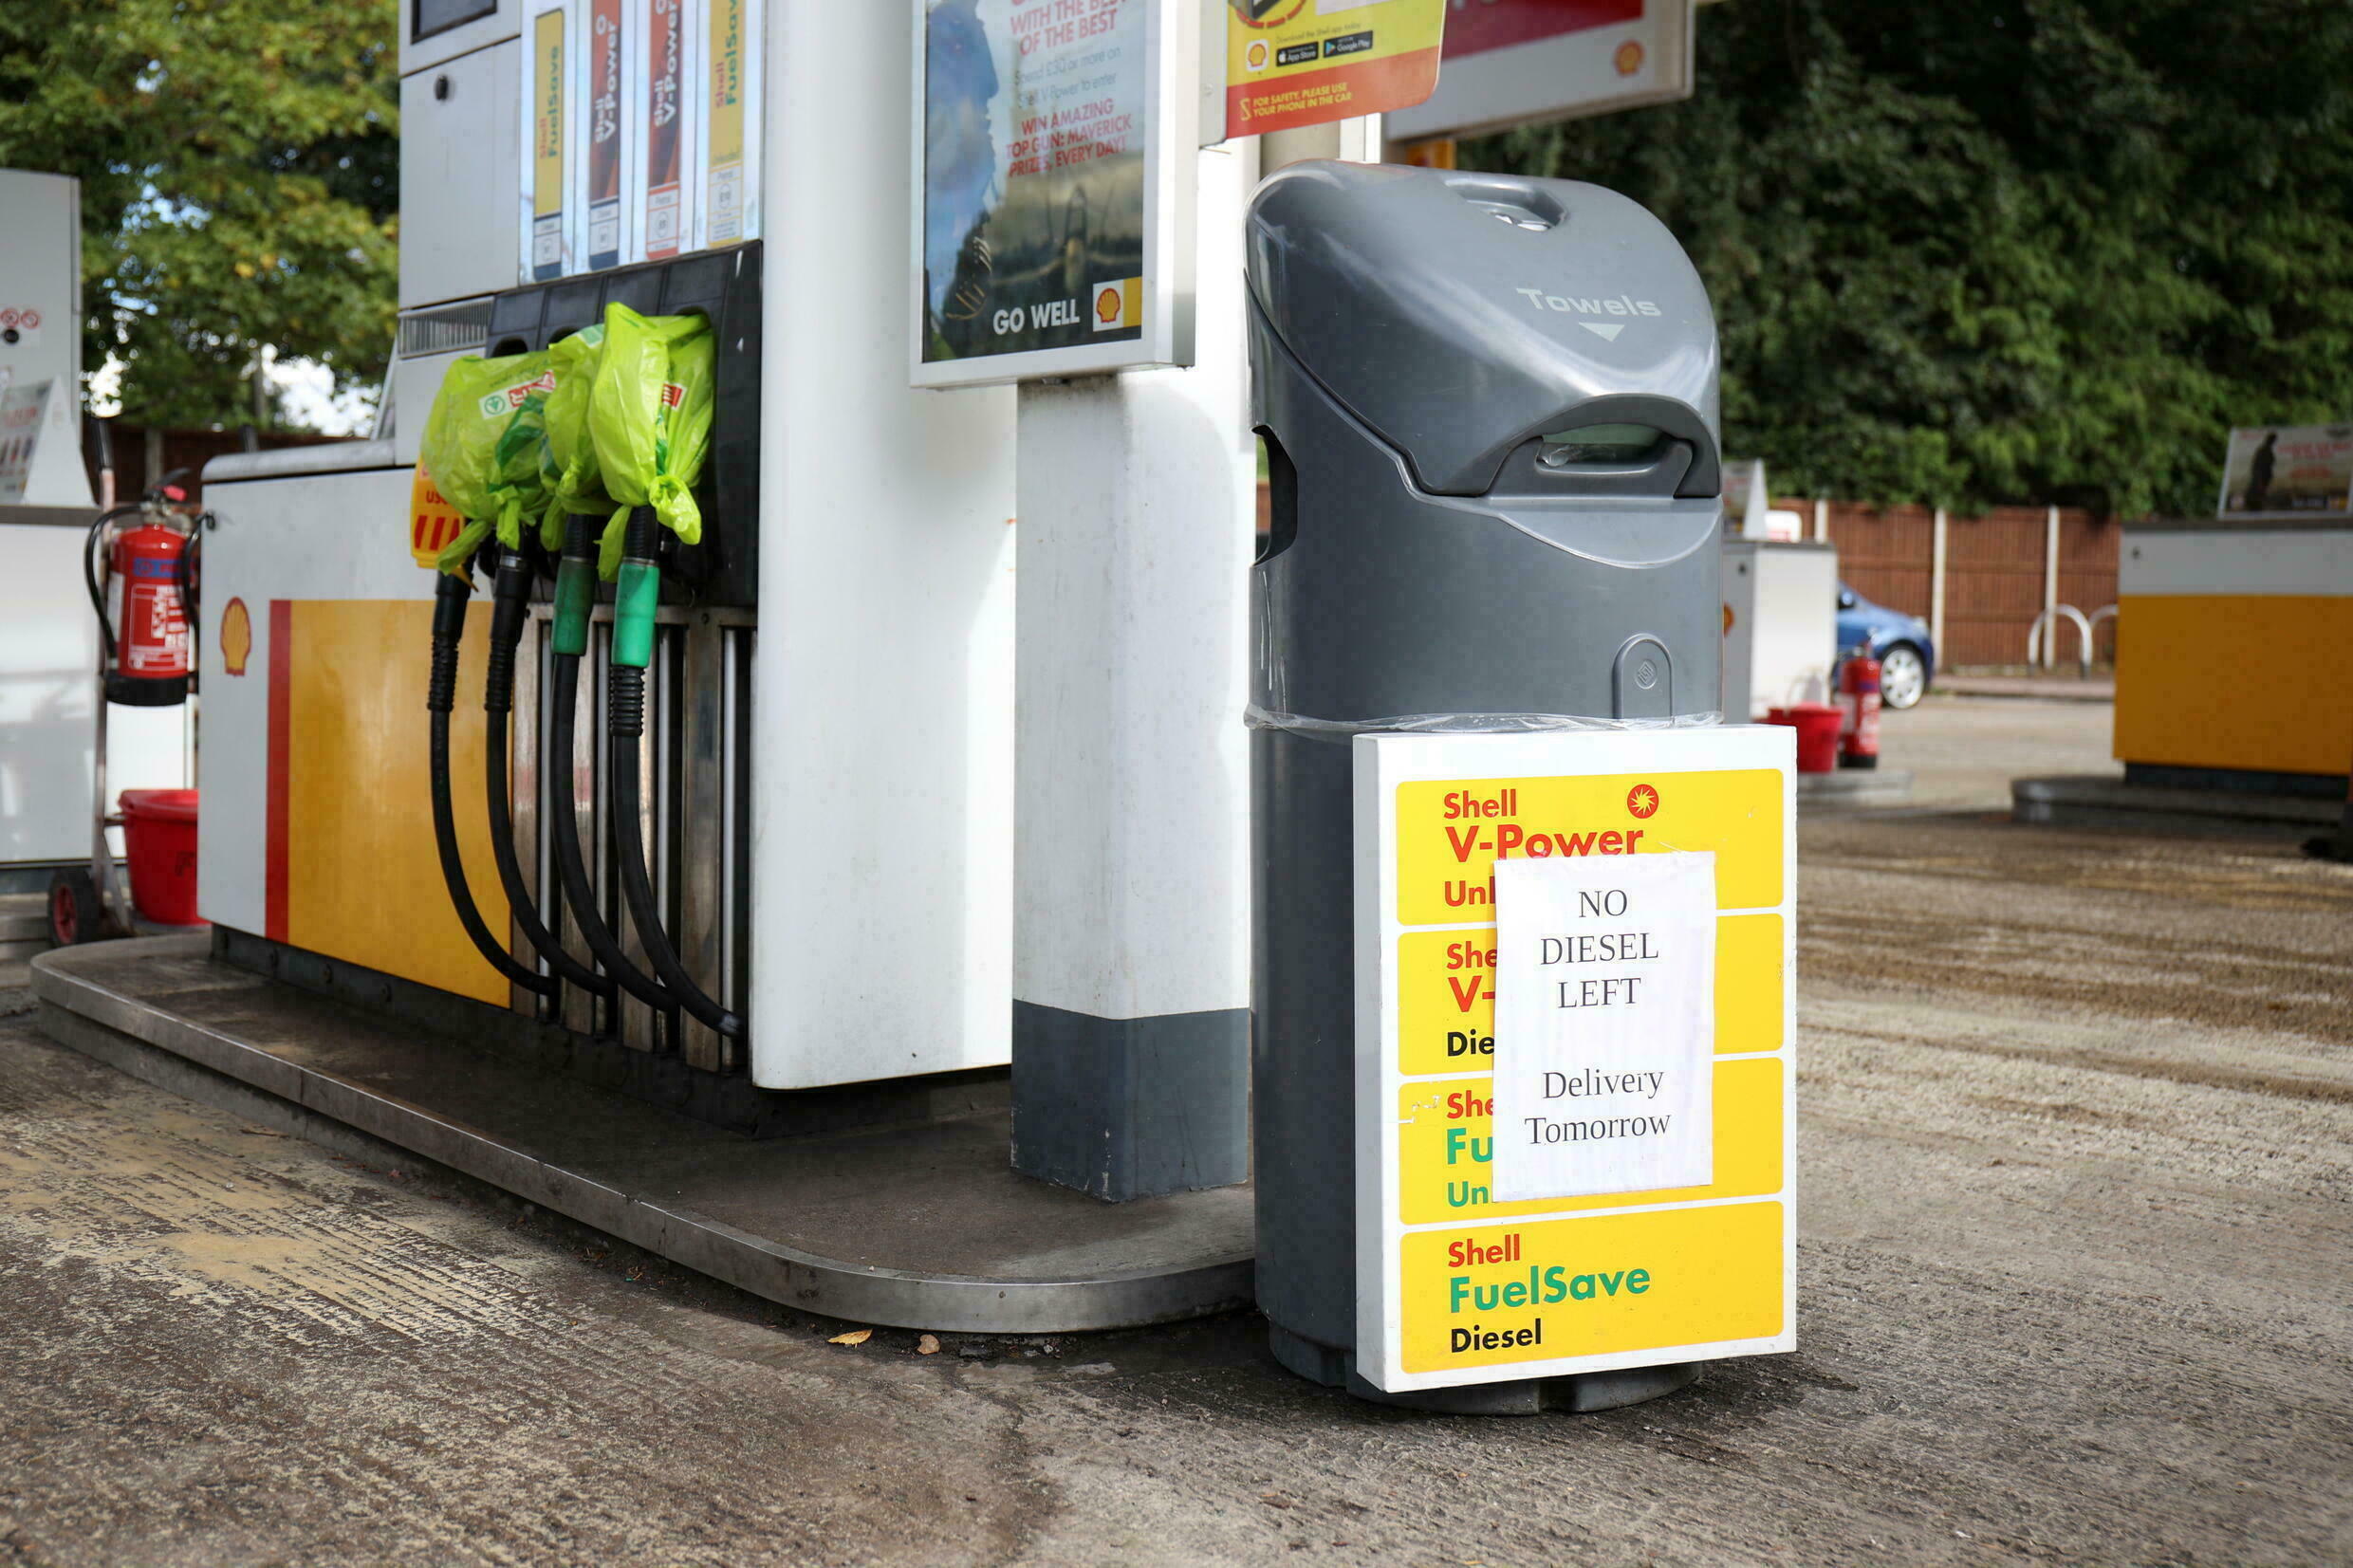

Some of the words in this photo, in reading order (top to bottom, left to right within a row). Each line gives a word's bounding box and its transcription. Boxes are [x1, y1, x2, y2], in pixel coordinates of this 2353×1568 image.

[1010, 3, 1051, 35] WITH
[1054, 0, 1084, 22] THE
[1019, 30, 1041, 56] OF
[1045, 21, 1074, 48] THE
[1079, 8, 1118, 39] BEST
[1337, 43, 1358, 53] Google
[603, 21, 617, 142] V-Power
[1253, 96, 1269, 107] FOR
[1302, 84, 1330, 98] PLEASE
[1331, 82, 1347, 94] USE
[1022, 114, 1047, 136] WIN
[1051, 98, 1115, 129] AMAZING
[1253, 105, 1277, 118] YOUR
[1277, 101, 1306, 113] PHONE
[1307, 98, 1318, 107] IN
[1320, 95, 1334, 106] THE
[1335, 92, 1352, 103] CAR
[1006, 139, 1029, 160] TOP
[1031, 131, 1065, 153] GUN:
[1067, 114, 1132, 145] MAVERICK
[1055, 143, 1093, 168] EVERY
[992, 306, 1025, 335] GO
[1030, 299, 1081, 330] WELL
[1516, 287, 1662, 317] Towels
[1443, 788, 1517, 820] Shell
[1445, 823, 1643, 862] V-Power
[1578, 889, 1628, 918] NO
[1540, 932, 1659, 966] DIESEL
[1557, 977, 1641, 1009] LEFT
[1543, 1068, 1665, 1099] Delivery
[1524, 1115, 1673, 1145] Tomorrow
[1448, 1233, 1520, 1268] Shell
[1450, 1264, 1651, 1314] FuelSave
[1451, 1318, 1542, 1354] Diesel
